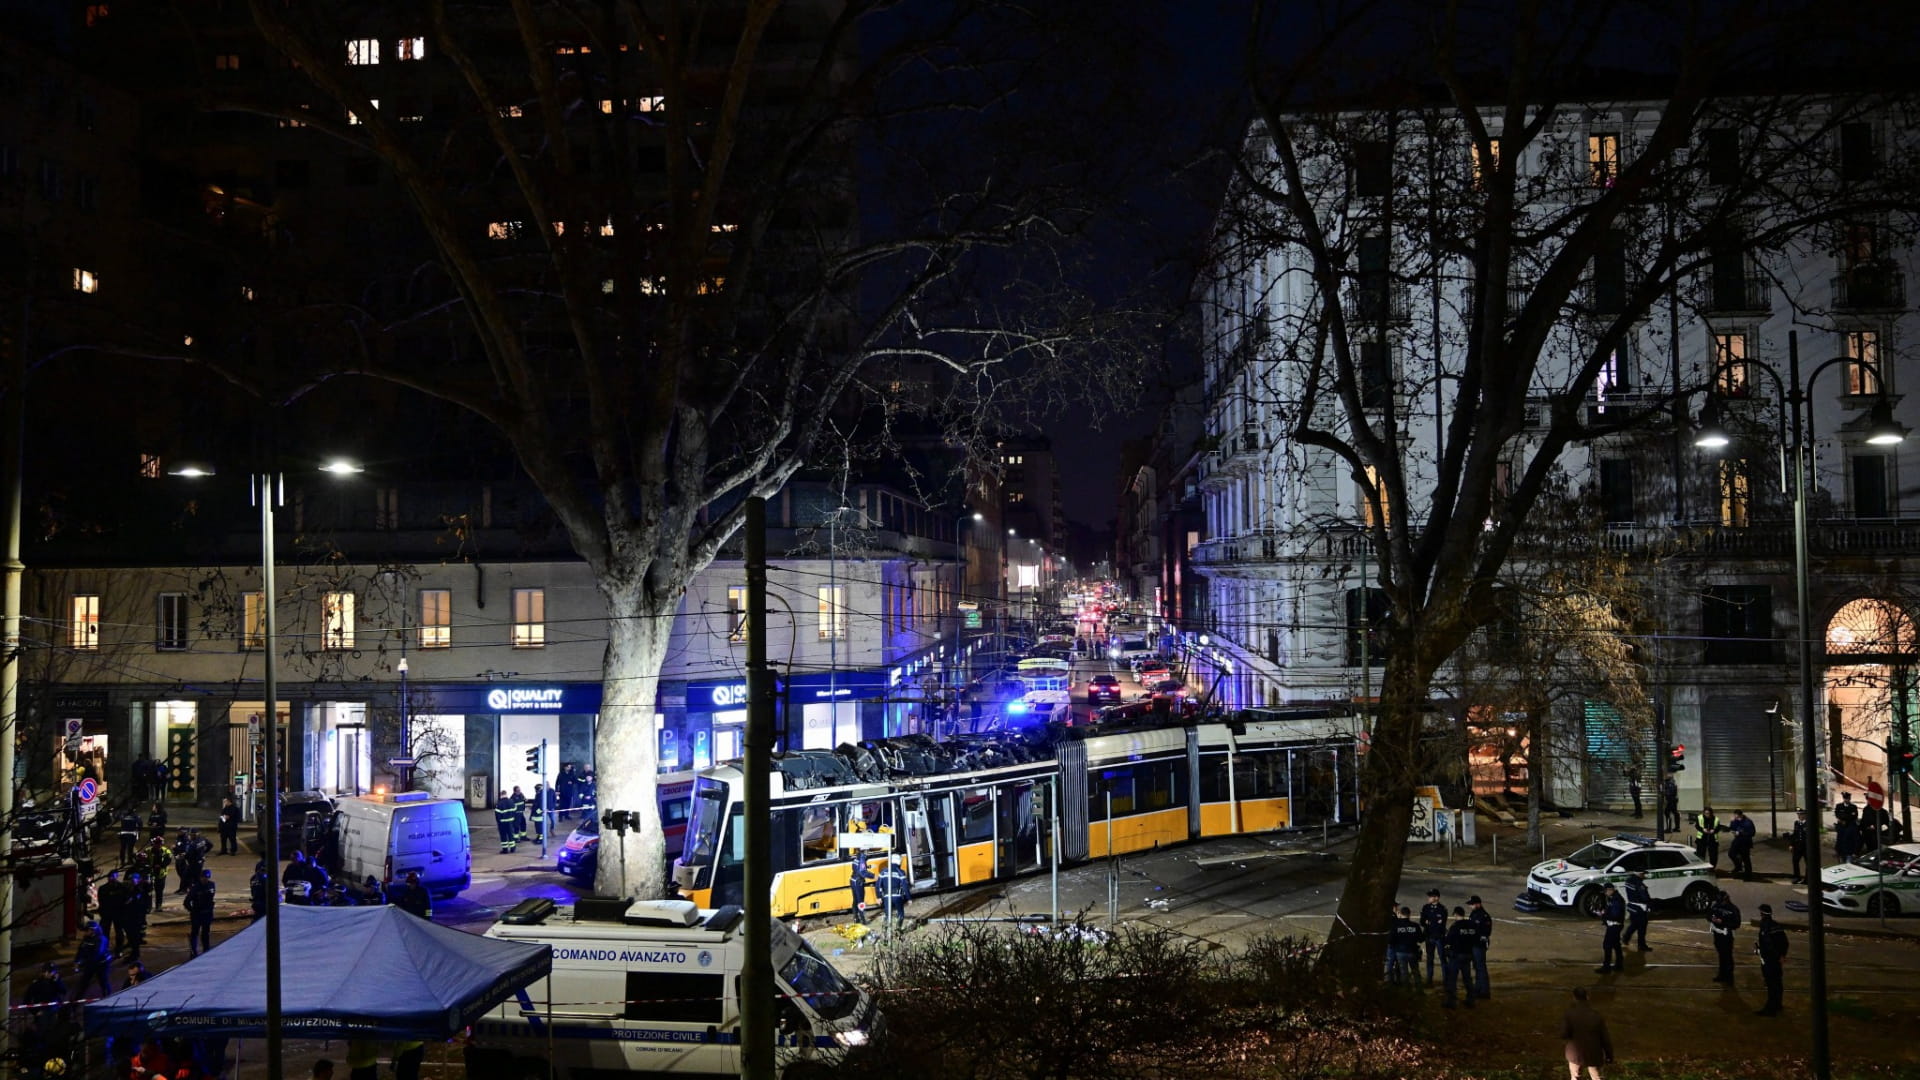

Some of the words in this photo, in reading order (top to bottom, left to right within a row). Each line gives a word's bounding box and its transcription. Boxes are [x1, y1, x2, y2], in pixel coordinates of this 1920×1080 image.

[511, 690, 562, 702] QUALITY
[662, 730, 673, 745] P
[697, 731, 706, 746] P
[552, 948, 617, 961] COMANDO
[619, 951, 686, 963] AVANZATO
[174, 1016, 216, 1025] COMUNE
[222, 1016, 232, 1025] DI
[237, 1017, 269, 1026] MILAN
[280, 1018, 342, 1027] PROTEZIONE
[611, 1030, 670, 1040] PROTEZIONE
[672, 1031, 702, 1041] CIVILE
